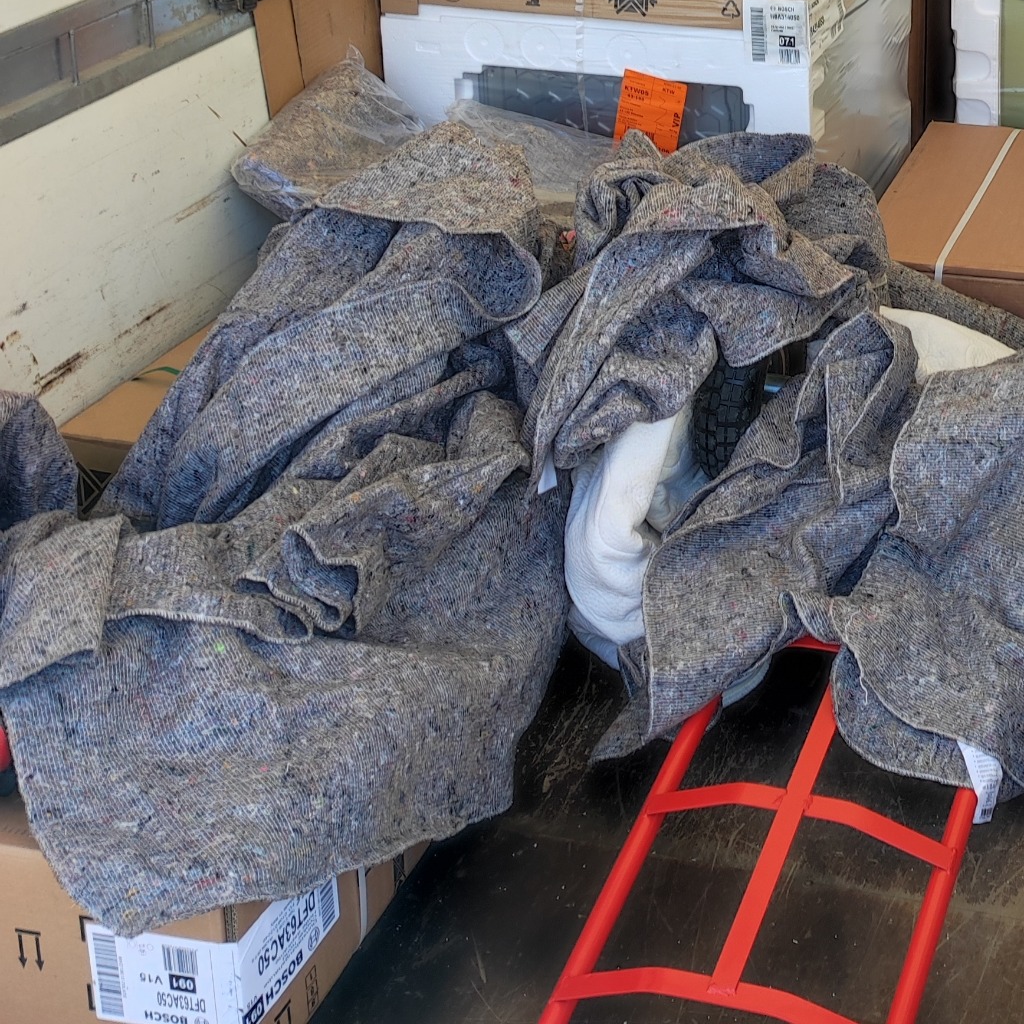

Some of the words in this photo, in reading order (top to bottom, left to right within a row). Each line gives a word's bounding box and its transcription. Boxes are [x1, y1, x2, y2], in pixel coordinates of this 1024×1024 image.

[779, 36, 795, 47] 071
[672, 113, 681, 128] VIP
[257, 890, 315, 977] DFT63AC50
[172, 976, 195, 991] 091
[265, 948, 303, 1006] BOSCH
[156, 991, 206, 1014] DFT63AC50
[143, 1009, 189, 1024] BOSCH
